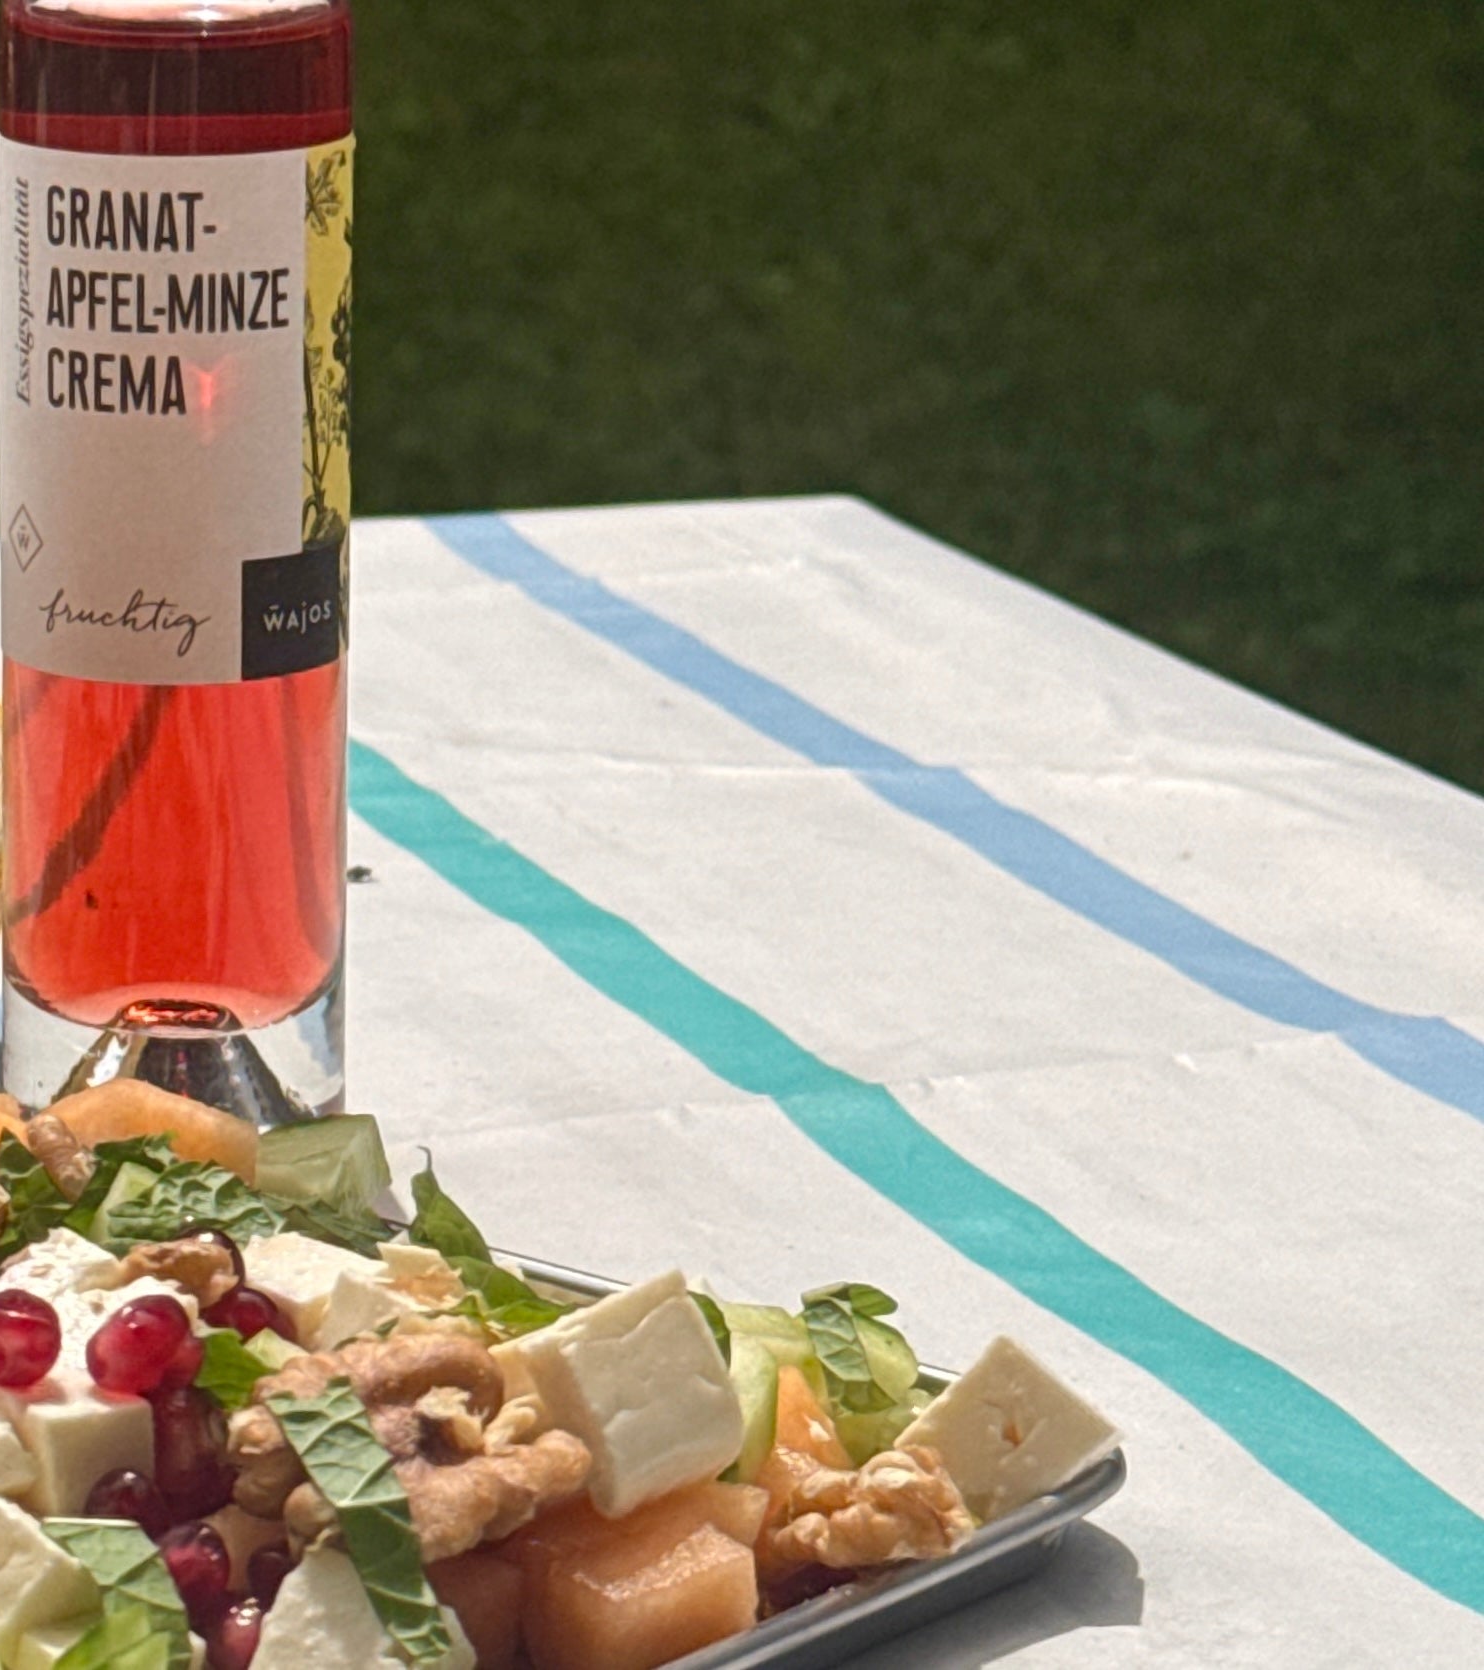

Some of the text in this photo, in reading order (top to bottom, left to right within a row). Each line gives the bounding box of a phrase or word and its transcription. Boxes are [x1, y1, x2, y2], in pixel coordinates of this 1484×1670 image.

[46, 185, 217, 252] GRANAT-
[14, 176, 35, 406] Essigspezialität
[46, 267, 290, 334] APFEL-MINZE
[47, 347, 188, 415] CREMA
[39, 588, 211, 657] fruchtig
